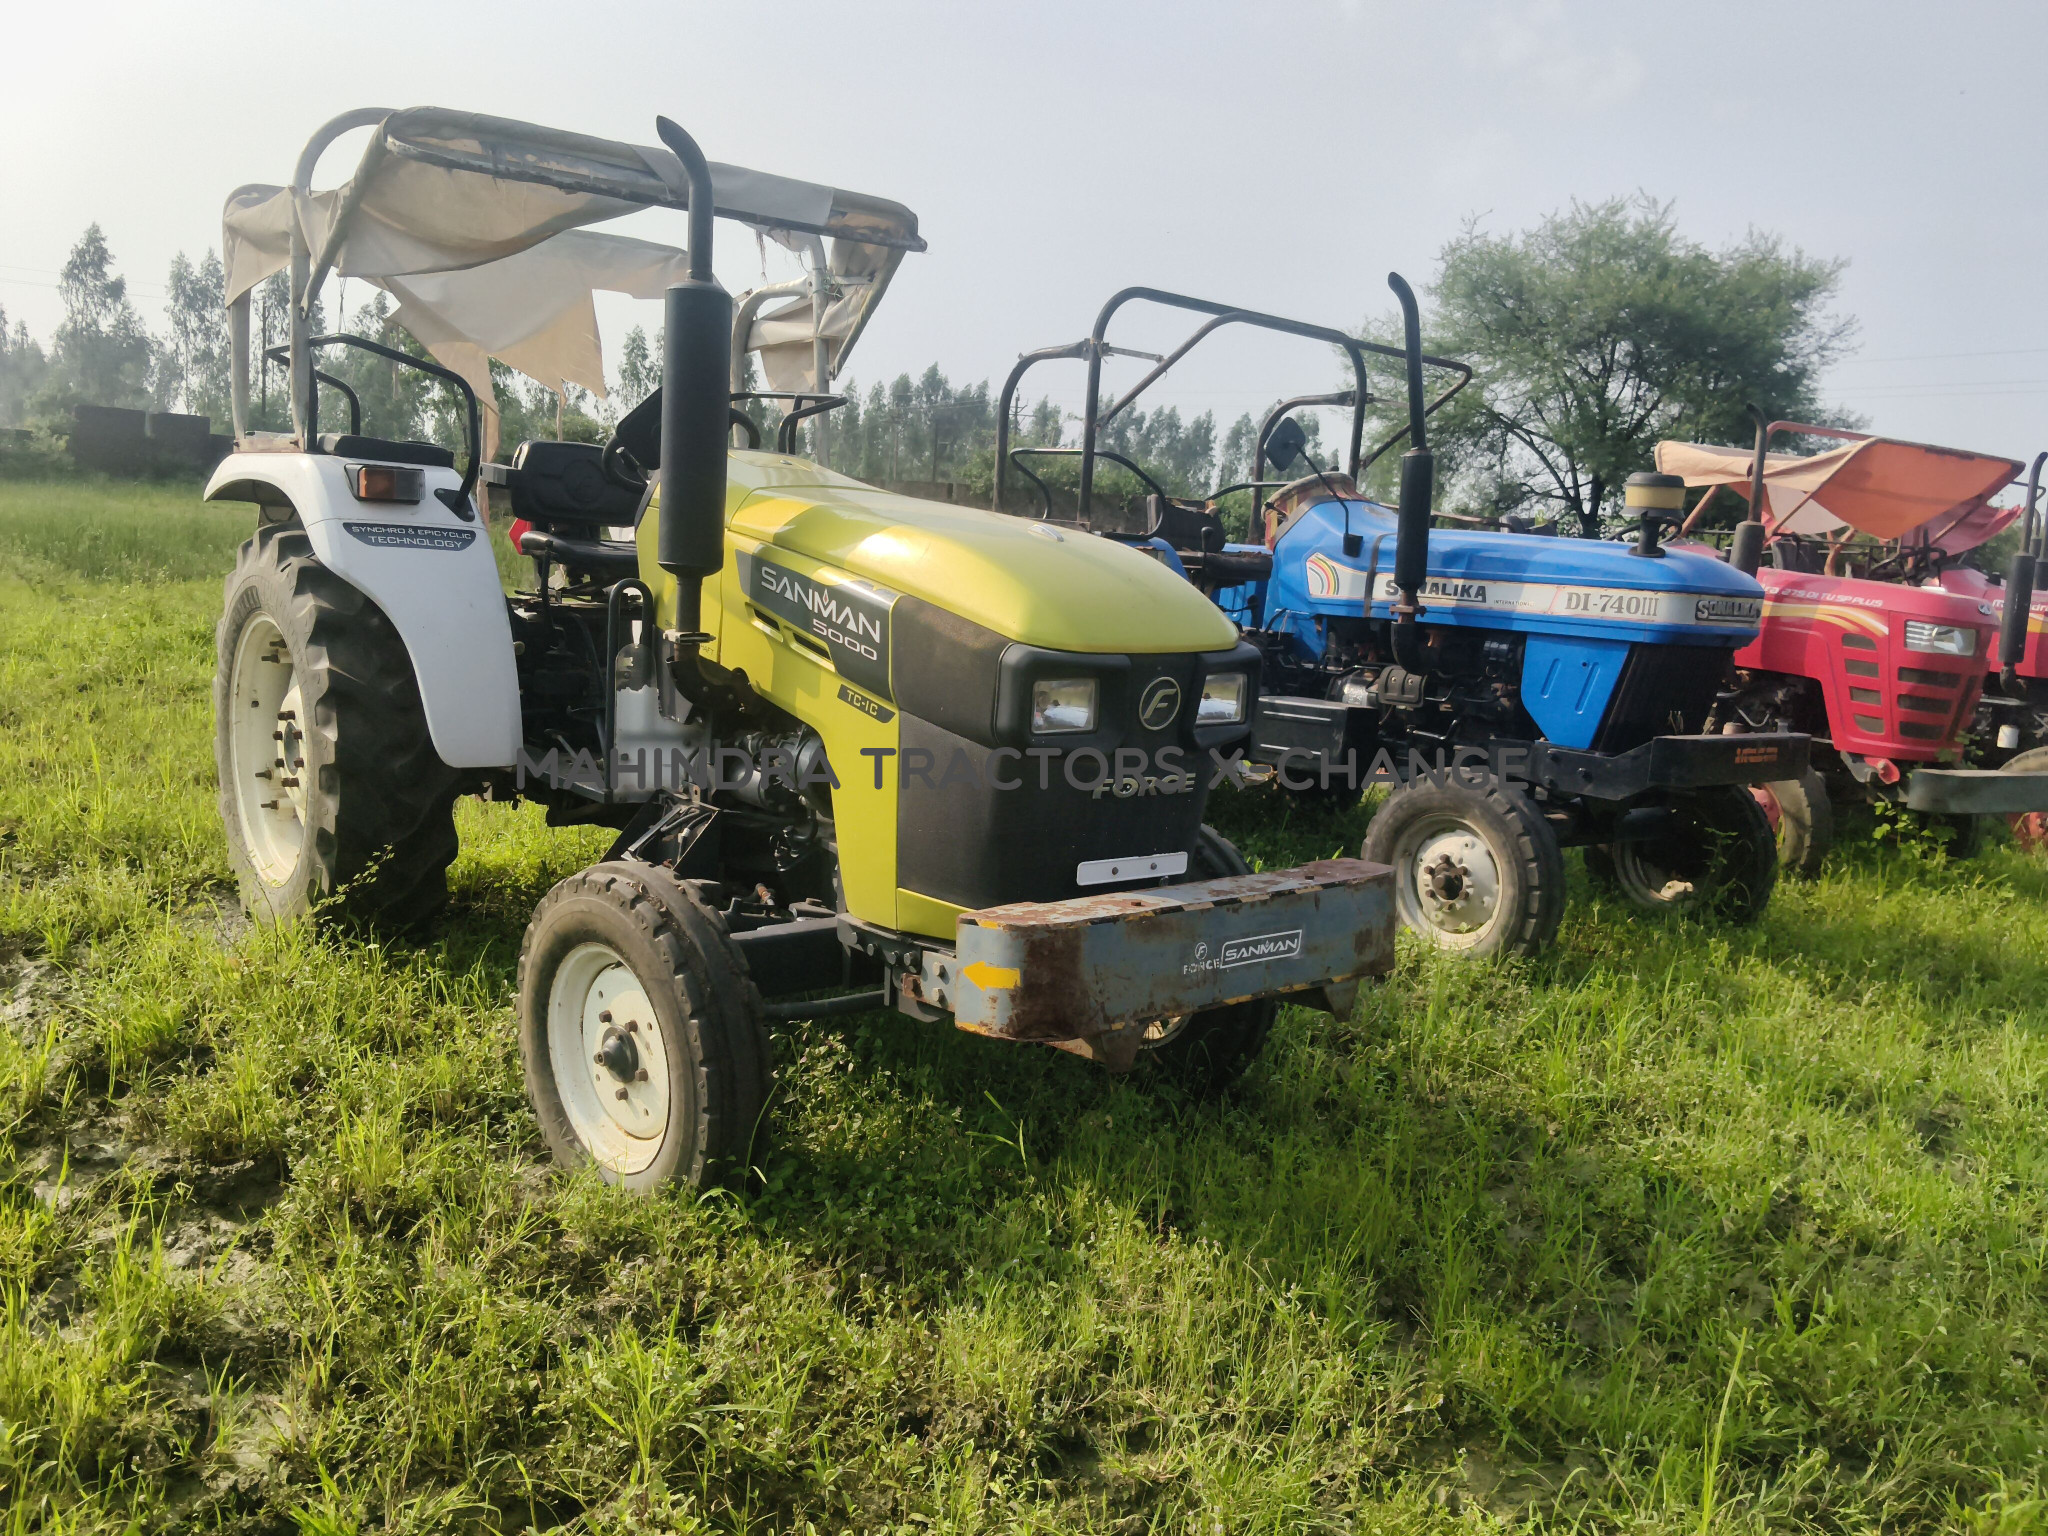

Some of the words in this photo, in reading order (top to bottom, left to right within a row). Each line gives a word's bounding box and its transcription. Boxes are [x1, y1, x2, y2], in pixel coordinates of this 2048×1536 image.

[352, 526, 405, 535] SYNCHRO
[408, 527, 415, 535] &
[418, 529, 472, 540] EPICYCLIC
[368, 536, 462, 548] TECHNOLOGY
[1385, 580, 1486, 603] SNALIKA
[761, 566, 880, 643] SANMAN
[813, 618, 877, 661] 5000
[1225, 938, 1298, 962] SANMAN
